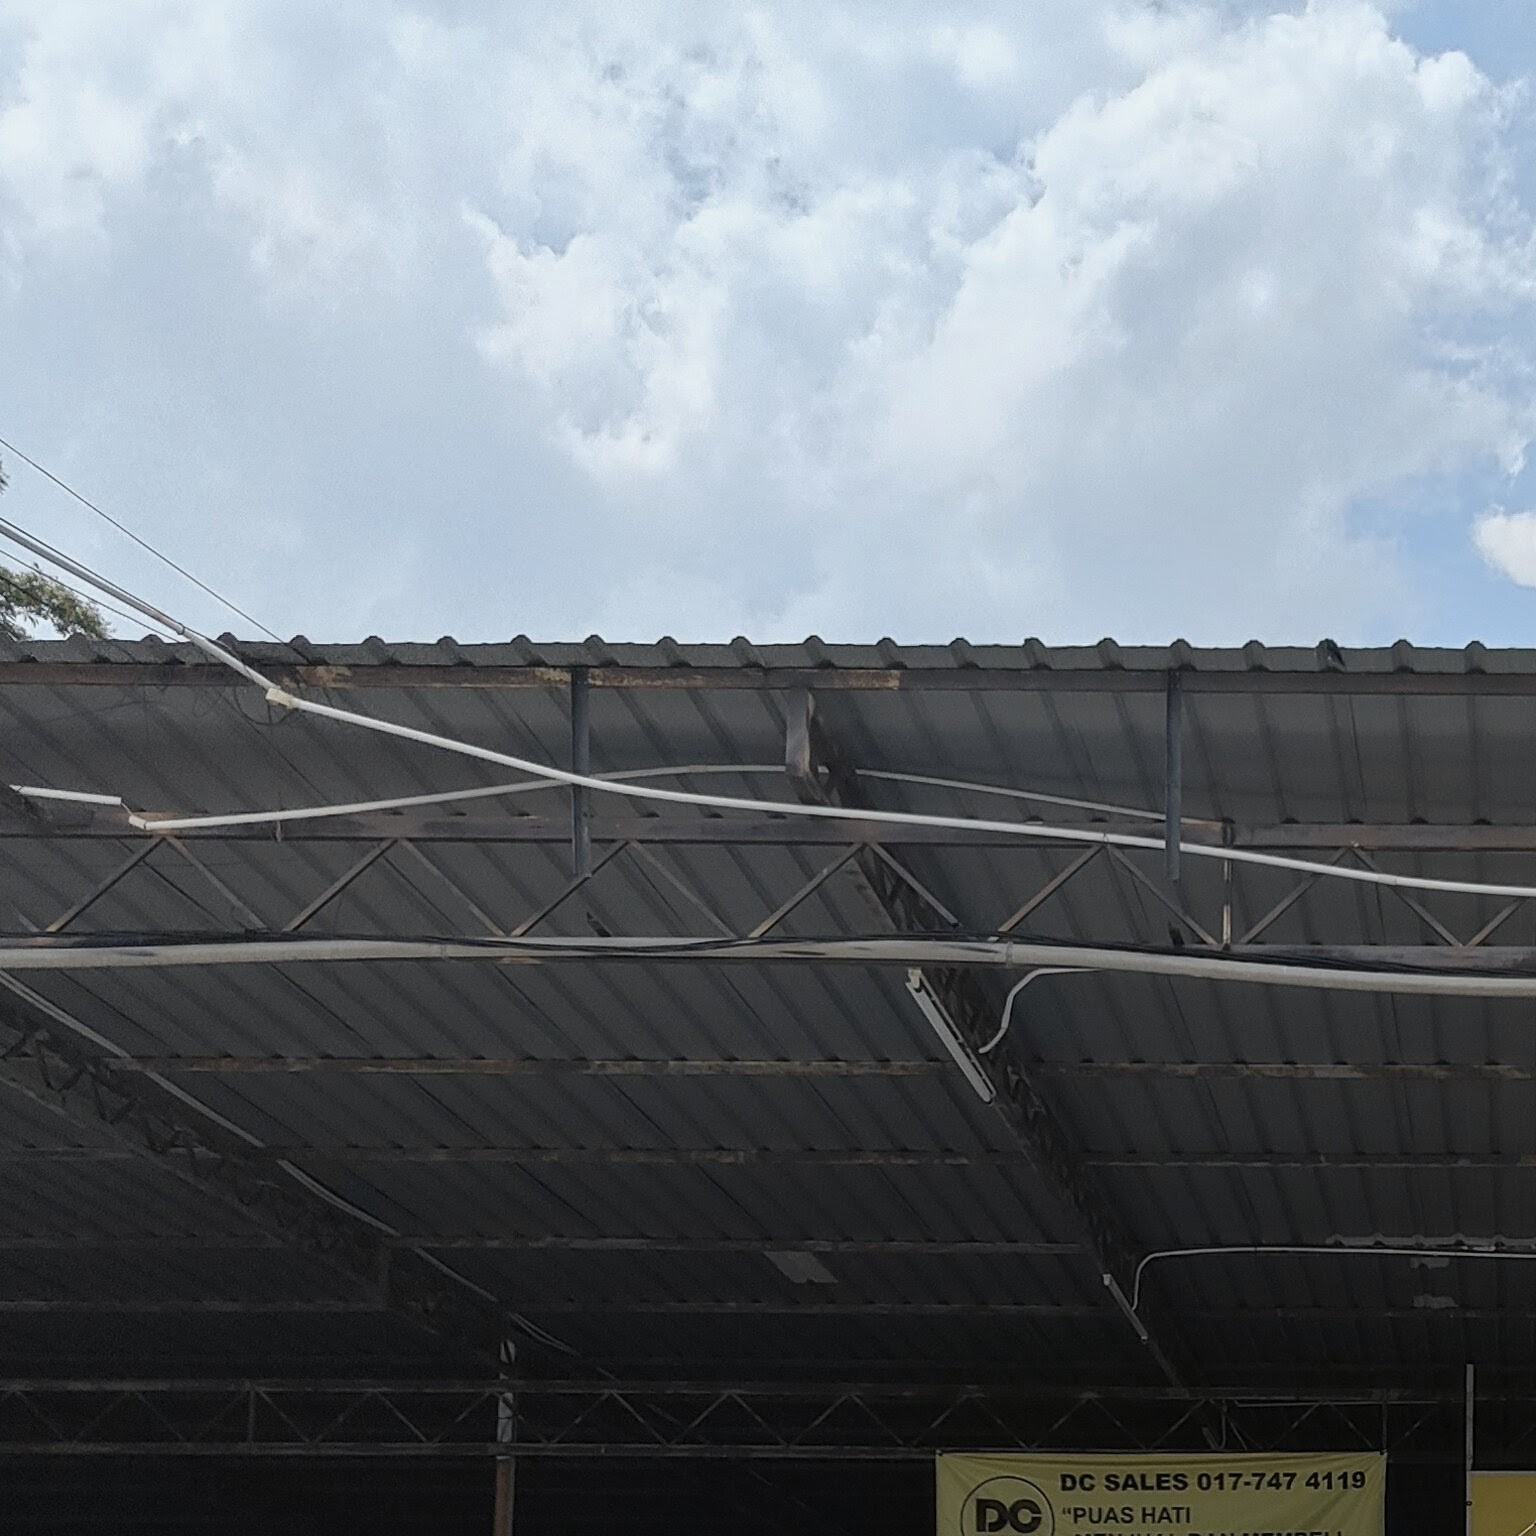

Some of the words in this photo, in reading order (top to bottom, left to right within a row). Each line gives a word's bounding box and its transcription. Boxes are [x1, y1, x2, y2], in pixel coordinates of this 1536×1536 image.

[1060, 1473, 1096, 1492] DC
[1103, 1473, 1189, 1492] SALES
[1196, 1472, 1297, 1491] 017-747
[1304, 1470, 1367, 1490] 4119
[975, 1498, 1043, 1533] DC
[1061, 1506, 1135, 1525] “PUAS
[1141, 1506, 1191, 1524] HATI
